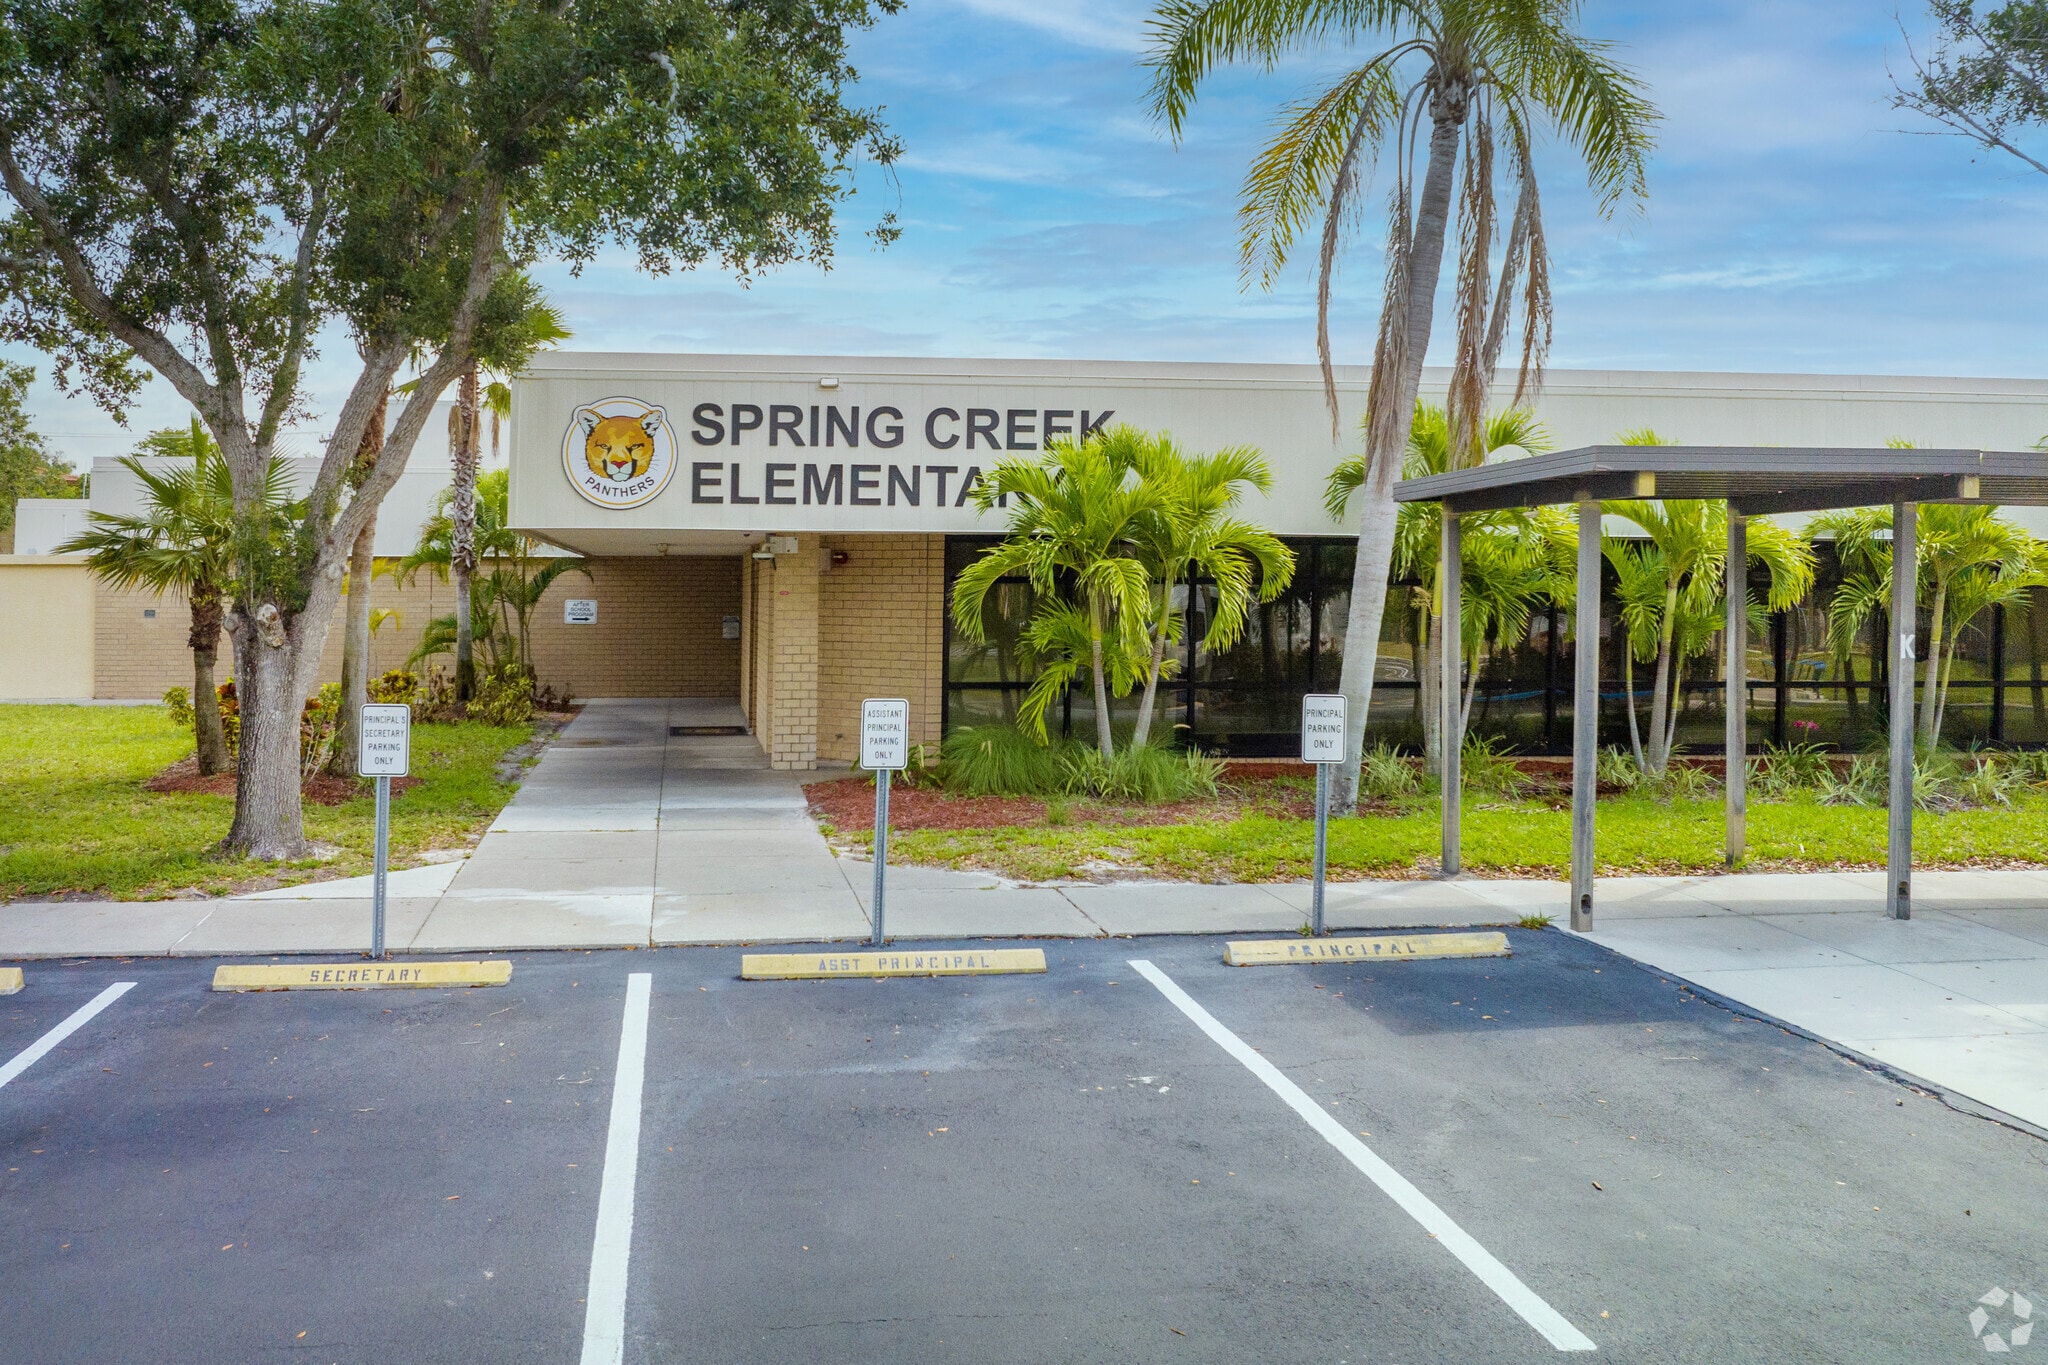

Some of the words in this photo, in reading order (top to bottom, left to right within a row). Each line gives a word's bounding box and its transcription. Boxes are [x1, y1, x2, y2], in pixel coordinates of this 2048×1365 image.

[691, 402, 904, 448] SPRING
[924, 407, 1116, 450] CREEK
[585, 476, 655, 497] PANTHERS
[691, 462, 1066, 508] ELEMENTA
[1900, 634, 1916, 659] K
[867, 710, 903, 718] ASSISTANT
[1306, 709, 1343, 719] PRINCIPAL
[364, 715, 406, 724] PRINCIPAL'S
[867, 724, 902, 732] PRINCIPAL
[1307, 724, 1342, 734] PARKING
[364, 729, 405, 738] SECRETARY
[869, 737, 899, 746] PARKING
[1313, 739, 1334, 749] ONLY
[368, 743, 401, 752] PARKING
[374, 756, 394, 765] ONLY
[874, 751, 893, 760] ONLY
[1288, 942, 1416, 957] PRINCIPAL
[818, 959, 860, 971] ASST
[878, 956, 990, 970] PRINCIPAL
[309, 968, 422, 983] SECRETARY
